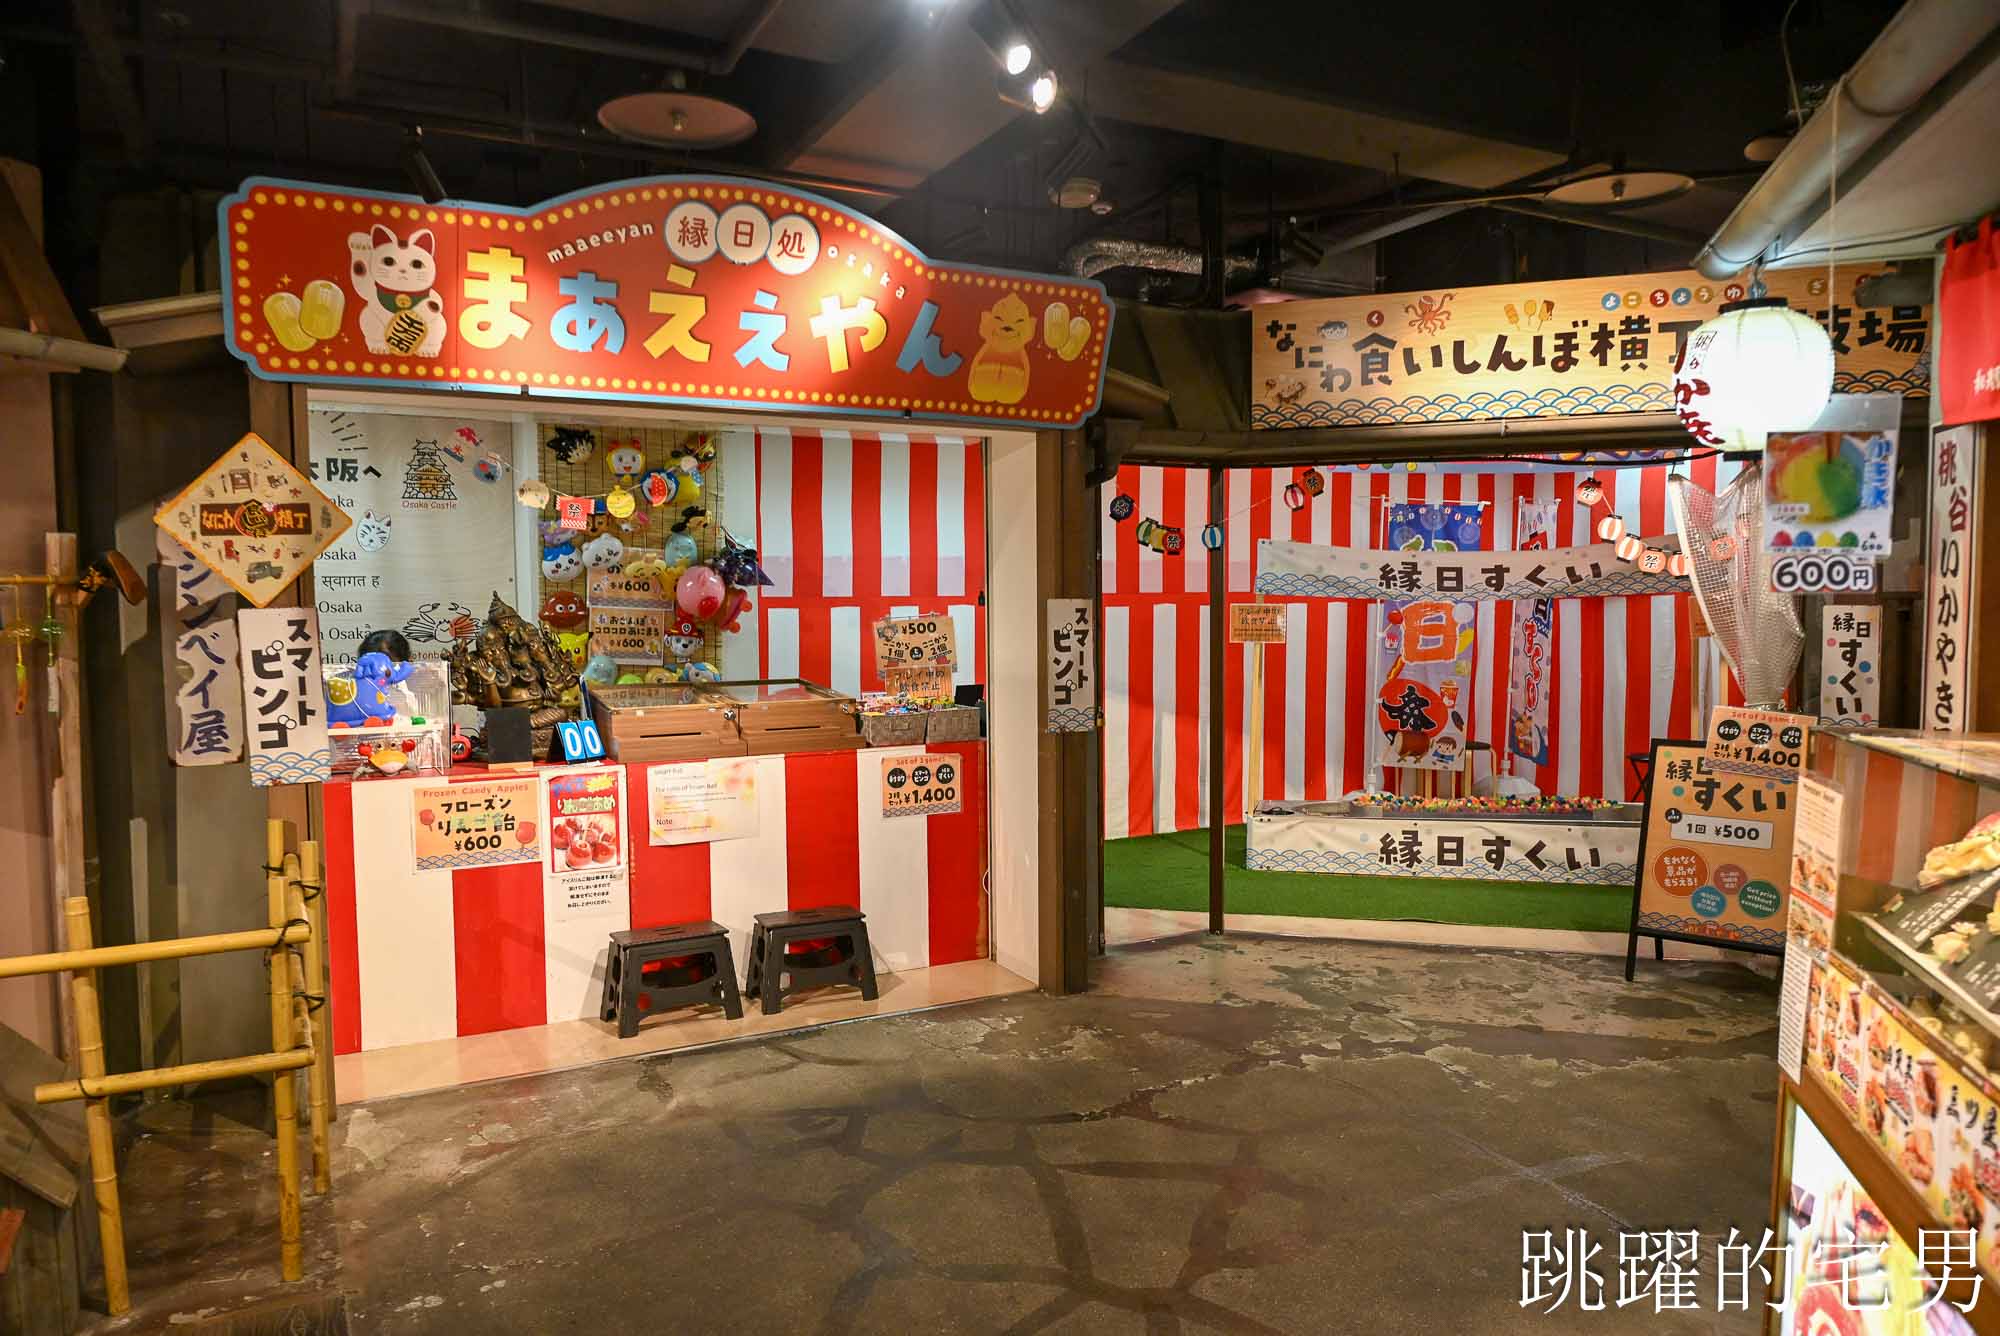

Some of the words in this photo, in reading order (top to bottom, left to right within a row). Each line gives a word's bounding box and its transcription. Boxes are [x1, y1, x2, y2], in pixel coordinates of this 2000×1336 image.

[547, 221, 655, 264] maaeeyan
[677, 215, 805, 260] 縁日処
[827, 245, 906, 299] osaka
[402, 500, 428, 509] Osaka
[430, 500, 457, 509] Castle
[1378, 562, 1601, 594] 縁日すくい
[1775, 558, 1870, 591] 600円
[1935, 440, 1968, 732] 桃谷いかやき
[319, 600, 363, 613] Osaka
[901, 622, 937, 635] ¥500
[1073, 607, 1089, 689] スマート
[1833, 612, 1871, 716] 縁日すくい
[287, 618, 316, 726] スマート
[1733, 747, 1801, 767] ¥1,400
[423, 790, 457, 799] Frozen
[462, 786, 491, 795] Candy
[496, 783, 529, 793] Apples
[440, 794, 512, 814] フローズン
[904, 787, 956, 804] ¥1,400
[1692, 778, 1787, 812] すくい
[656, 818, 673, 826] Note
[1687, 823, 1706, 834] 1回
[1714, 825, 1760, 841] ¥500
[454, 834, 502, 851] ¥600
[1379, 830, 1600, 872] 縁日すくい
